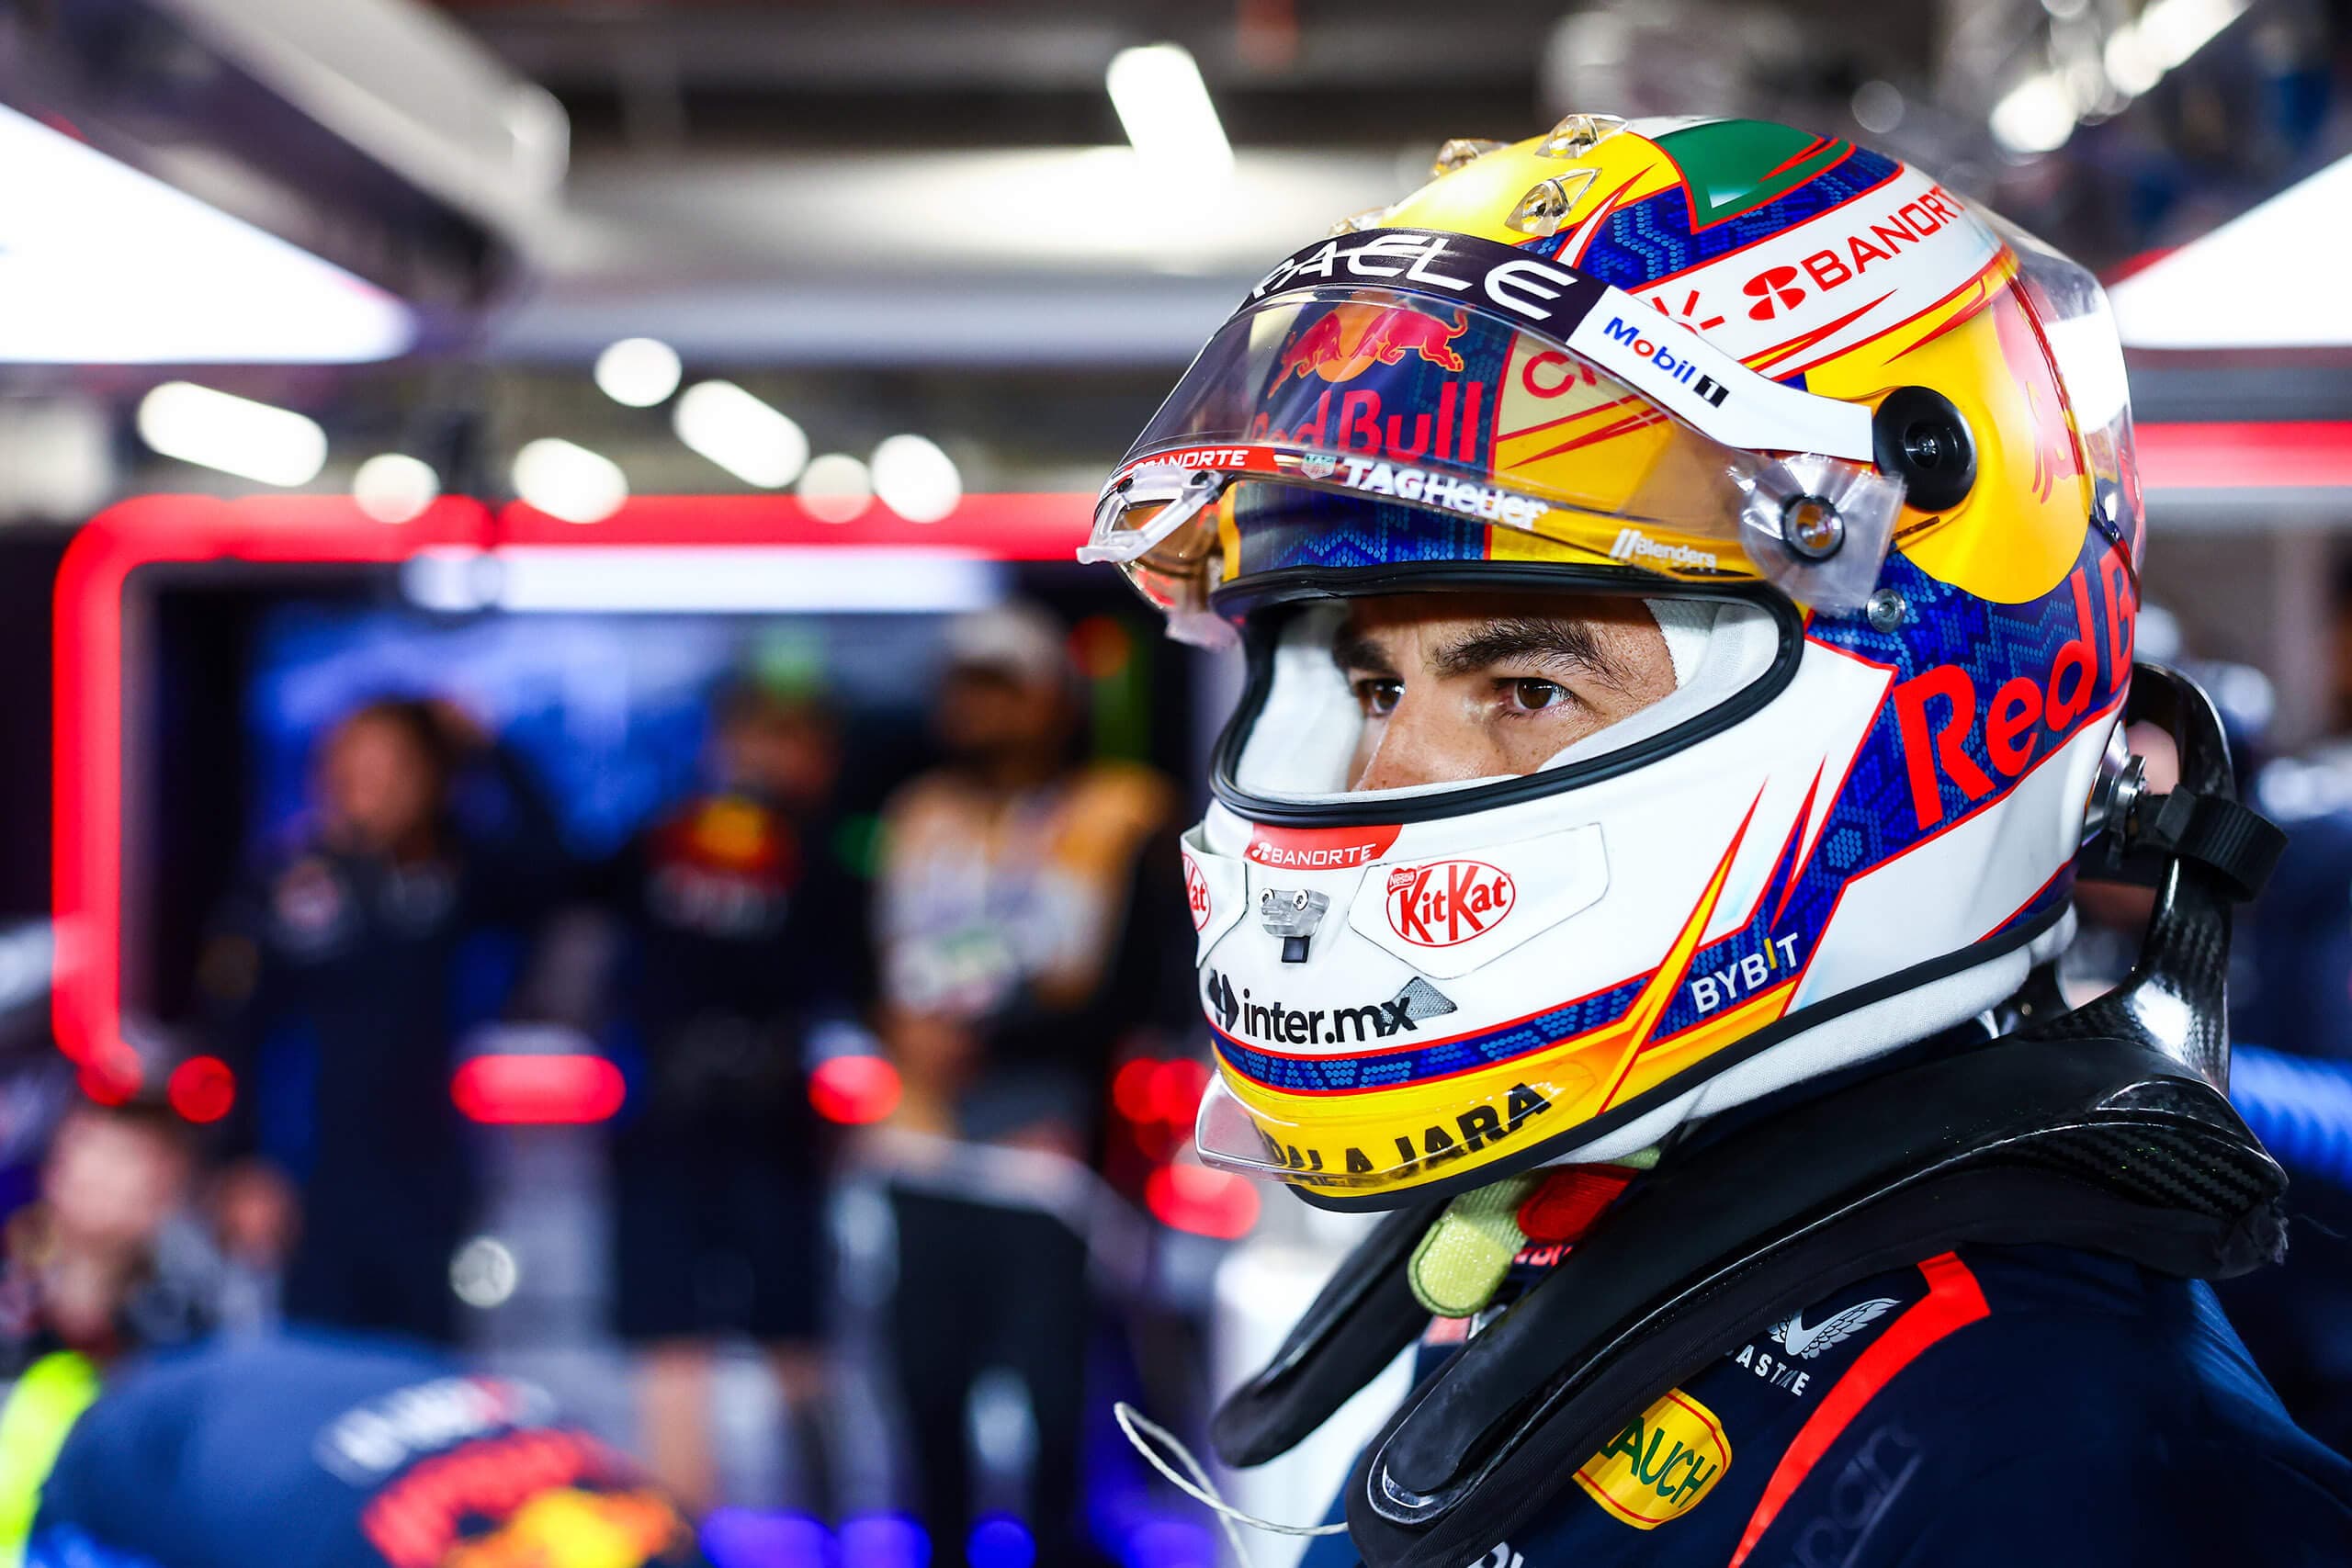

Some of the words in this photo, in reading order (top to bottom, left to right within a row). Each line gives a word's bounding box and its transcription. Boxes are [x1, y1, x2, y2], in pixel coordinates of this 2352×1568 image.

[1603, 316, 1697, 384] Mobil
[1337, 381, 1484, 463] Bull
[1893, 566, 2098, 831] Red
[1270, 843, 1377, 866] BANORTE
[1399, 864, 1508, 943] KitKat
[1690, 931, 1801, 1013] BYBIT
[1243, 987, 1419, 1044] inter.mx
[1600, 1416, 1718, 1509] AUCH
